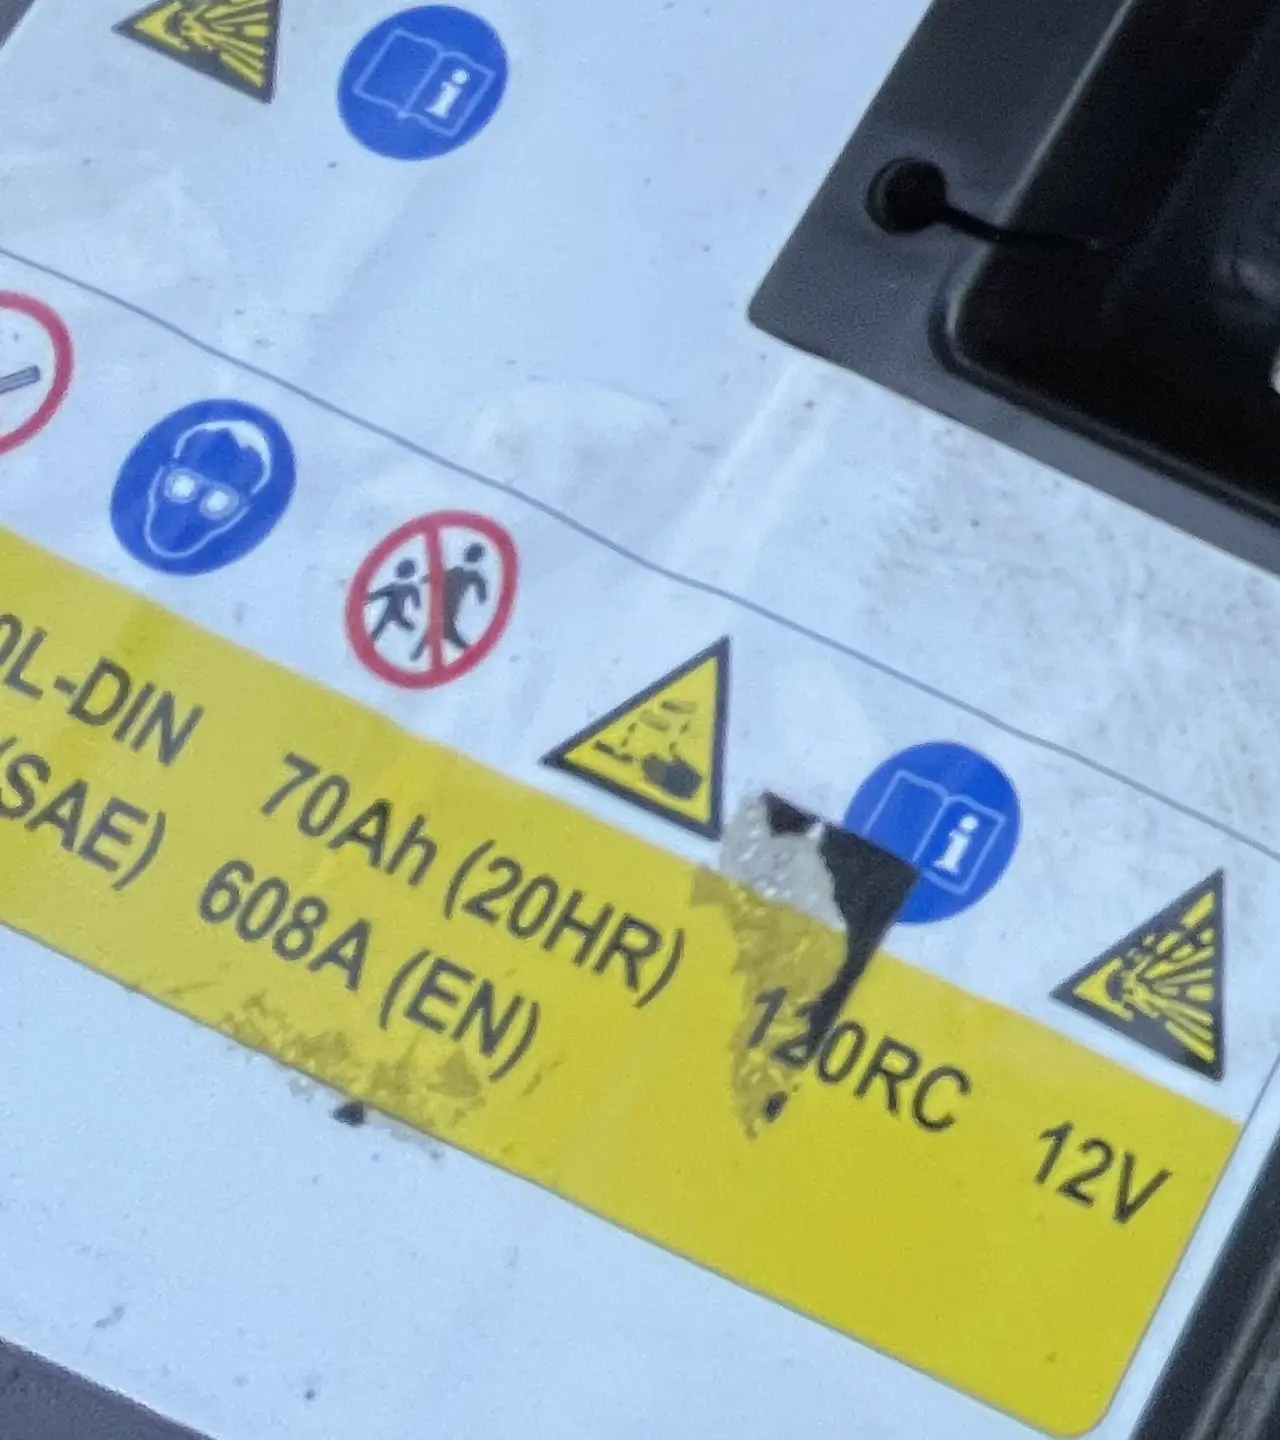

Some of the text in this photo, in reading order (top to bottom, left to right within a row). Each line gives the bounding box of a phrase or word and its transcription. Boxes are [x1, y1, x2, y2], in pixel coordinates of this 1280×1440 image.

[199, 860, 372, 992] 608A
[378, 949, 541, 1082] (EN)
[260, 752, 438, 886] 70Ah
[444, 839, 686, 1008] (20HR)
[1033, 1120, 1173, 1225] 12V
